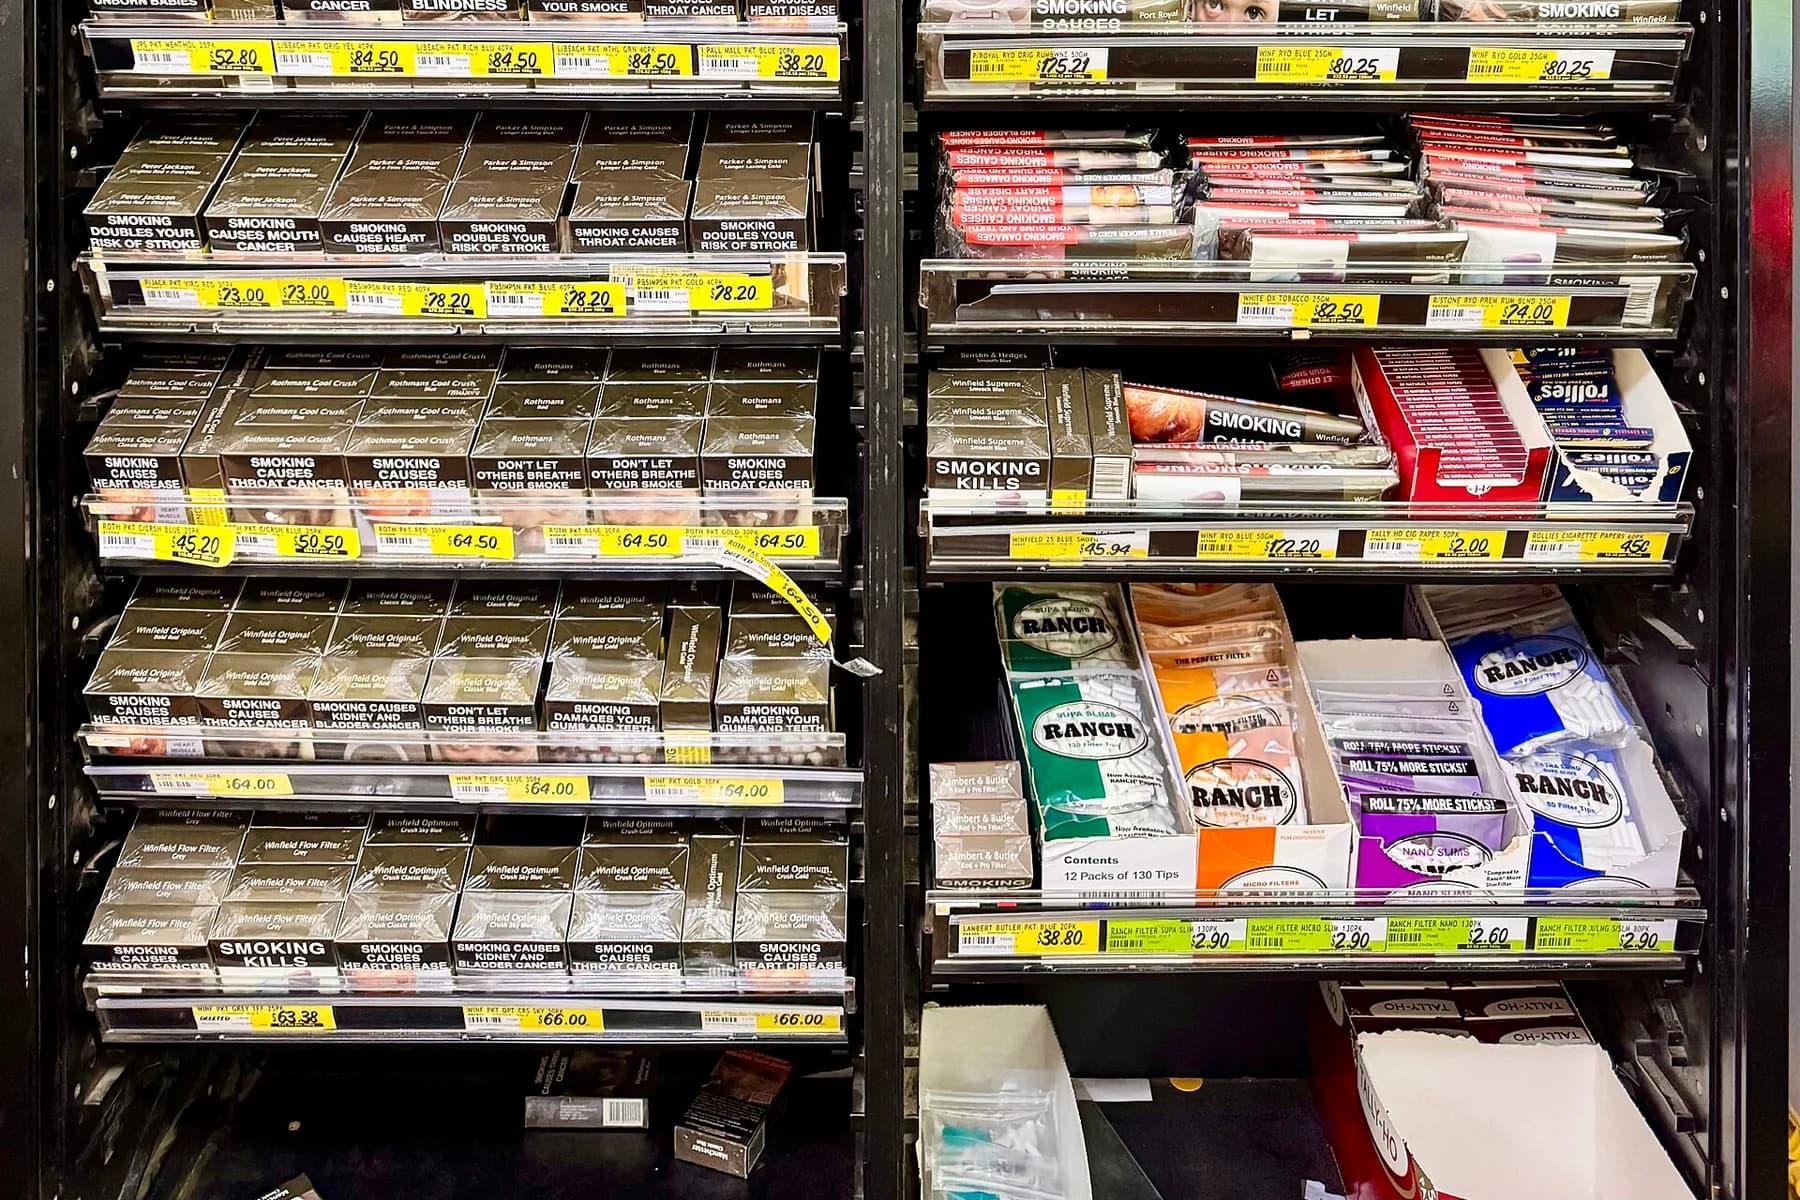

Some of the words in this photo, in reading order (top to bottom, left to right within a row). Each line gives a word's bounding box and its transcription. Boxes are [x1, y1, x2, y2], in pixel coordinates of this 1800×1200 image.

[310, 0, 370, 11] CANCER
[1036, 0, 1127, 15] SMOKING
[1377, 2, 1411, 12] Winfield
[1538, 3, 1620, 18] SMOKING
[1139, 10, 1155, 19] Port
[1158, 9, 1178, 20] Royal
[210, 49, 257, 67] $52.80
[351, 50, 398, 68] $84.50
[488, 53, 537, 69] $84.50
[628, 53, 676, 70] $84.50
[779, 54, 823, 70] $38.20
[1037, 58, 1090, 73] $175.21
[1329, 57, 1379, 74] $80.25
[1543, 60, 1593, 75] $80.25
[575, 227, 629, 238] SMOKING
[632, 227, 679, 237] CAUSES
[578, 237, 626, 248] THROAT
[629, 237, 677, 247] CANCER
[218, 289, 264, 304] $73.00
[282, 285, 329, 302] $73.00
[424, 292, 472, 308] $78.20
[564, 291, 609, 308] $78.20
[710, 284, 756, 302] $78.20
[1313, 303, 1363, 319] $82.50
[1502, 304, 1552, 320] $74.00
[1209, 411, 1301, 438] SMOKING
[512, 434, 552, 443] Rothmans
[1316, 433, 1349, 444] Winfield
[936, 461, 1041, 476] SMOKING
[956, 477, 1020, 490] KILLS
[172, 535, 219, 554] $45.20
[294, 536, 343, 550] $50.50
[455, 535, 497, 549] $64.50
[618, 534, 667, 548] $64.50
[755, 534, 804, 548] $64.50
[1451, 538, 1488, 553] $2.00
[1080, 542, 1130, 556] $45.94
[137, 627, 169, 635] Winfield
[172, 627, 203, 636] Original
[1022, 617, 1107, 634] RANCH
[1483, 649, 1574, 683] RANCH
[1043, 720, 1136, 739] RANCH
[1349, 760, 1372, 773] ROLL
[1374, 760, 1398, 773] 75%
[1400, 761, 1427, 774] MORE
[226, 778, 275, 790] $64.00
[525, 782, 574, 796] $64.00
[1516, 773, 1609, 804] RANCH
[1192, 786, 1280, 808] RANCH
[1369, 797, 1394, 811] ROLL
[1396, 798, 1420, 811] 75%
[1422, 798, 1453, 810] MORE
[1402, 847, 1434, 857] NANO
[1438, 847, 1470, 857] SLIMS
[1064, 856, 1119, 865] Contents
[1065, 872, 1077, 880] 12
[1080, 871, 1111, 880] Packs
[1114, 870, 1128, 880] of
[1131, 870, 1152, 879] 130
[1155, 870, 1179, 881] Tips
[112, 919, 145, 928] Winfield
[148, 920, 168, 928] Flow
[1037, 930, 1082, 946] $38.80
[1191, 933, 1229, 949] $2.90
[1331, 932, 1369, 949] $2.90
[1469, 928, 1508, 944] $2.60
[1619, 933, 1658, 949] $2.90
[219, 942, 326, 955] SMOKING
[243, 956, 308, 967] KILLS
[272, 1011, 318, 1024] $63.38
[538, 1013, 587, 1026] $66.00
[774, 1013, 823, 1026] $66.00
[1513, 1031, 1579, 1042] TALLY-HO
